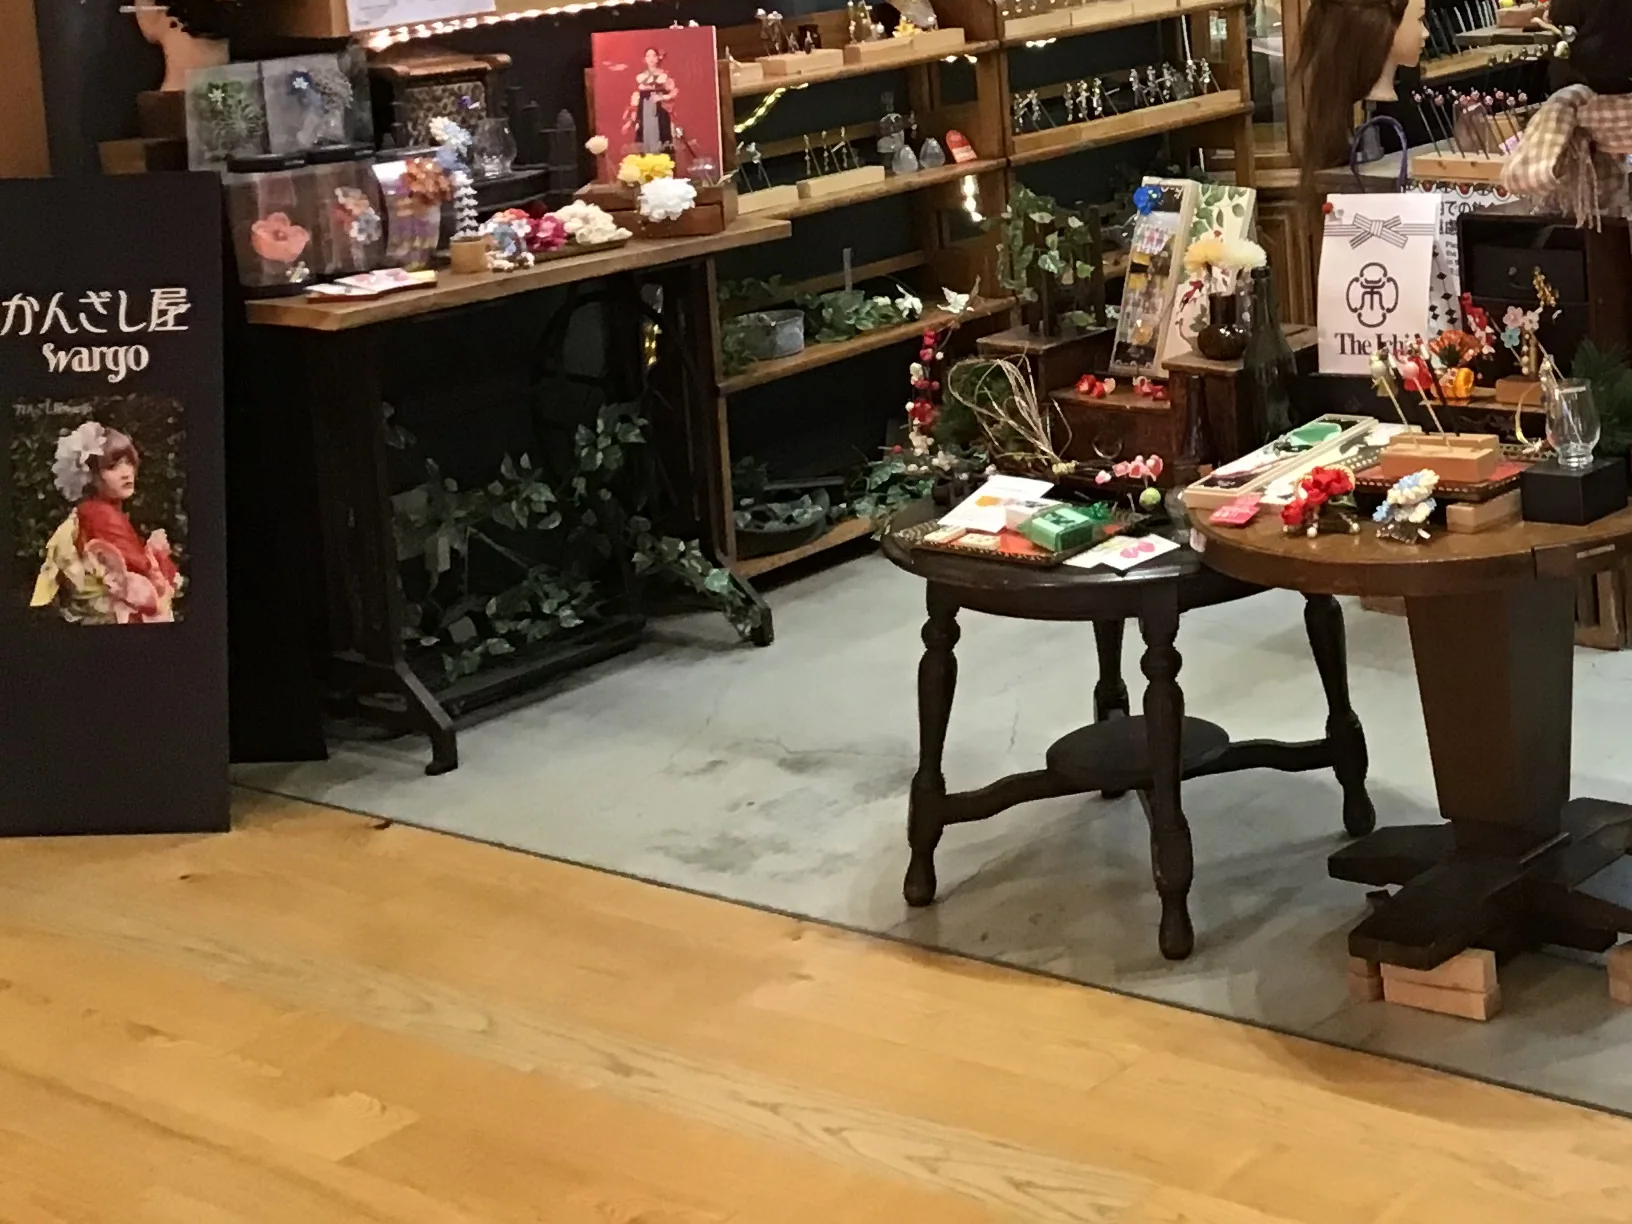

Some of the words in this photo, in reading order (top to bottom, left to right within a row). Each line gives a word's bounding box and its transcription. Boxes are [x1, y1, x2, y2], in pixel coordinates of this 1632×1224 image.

[0, 287, 192, 336] かんざし屋
[42, 342, 149, 383] wargo
[1334, 332, 1372, 356] The
[1375, 333, 1409, 355] Ich
